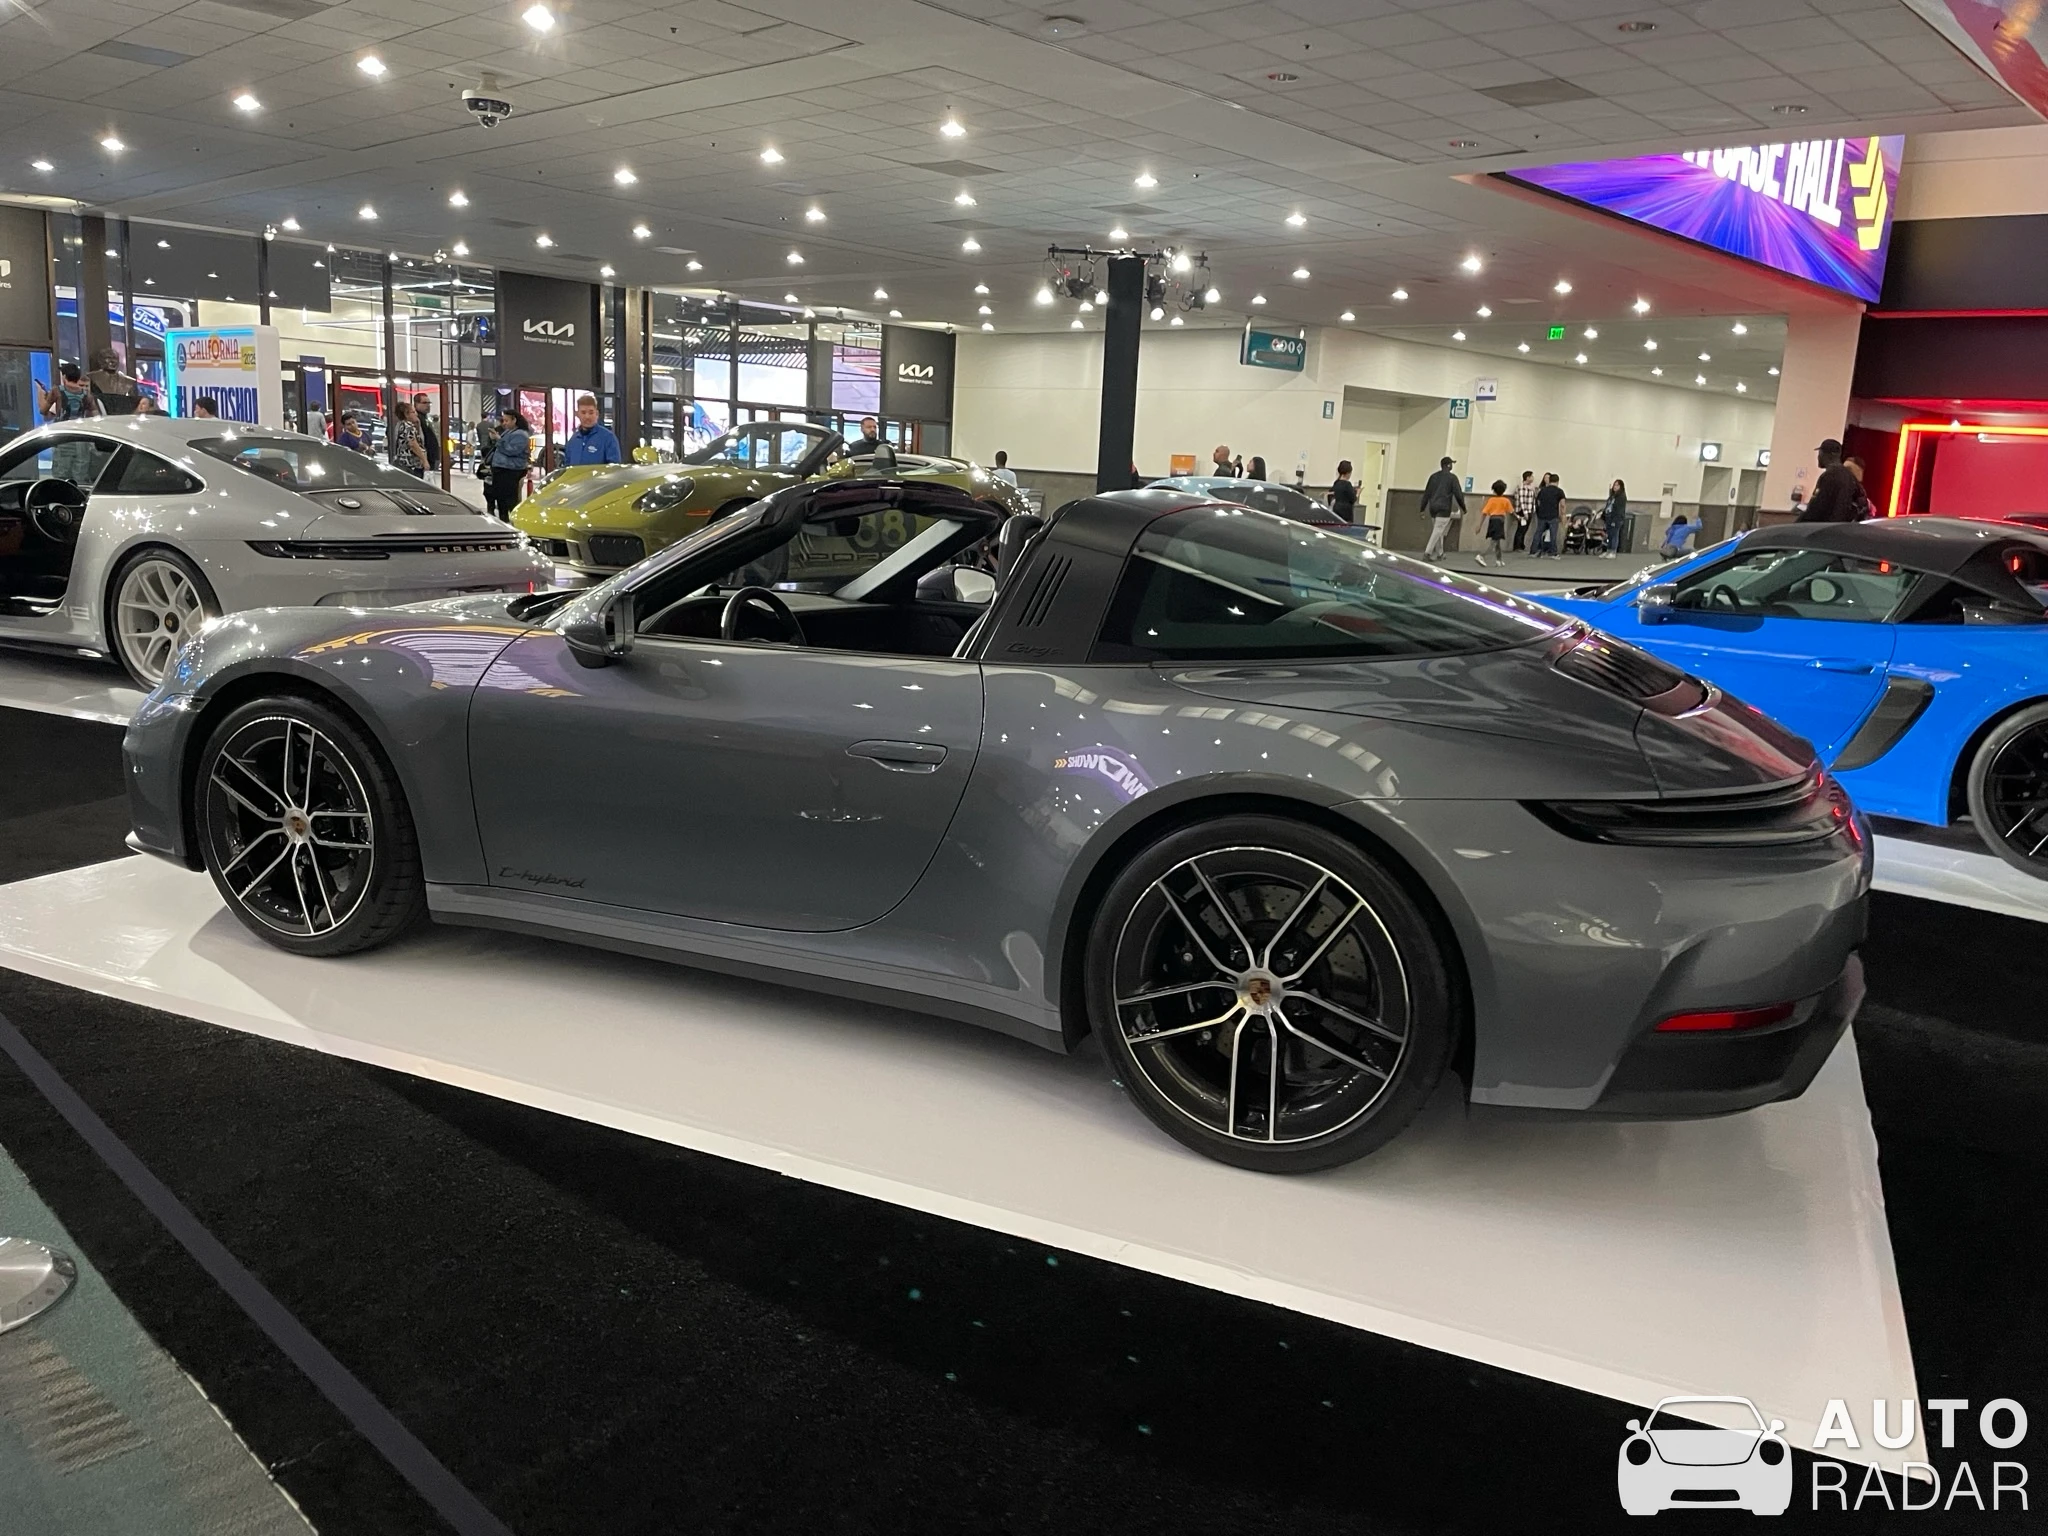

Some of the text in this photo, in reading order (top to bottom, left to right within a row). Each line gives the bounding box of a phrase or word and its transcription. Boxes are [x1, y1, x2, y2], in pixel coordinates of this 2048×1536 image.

[1783, 139, 1843, 228] HALL
[133, 307, 161, 332] Ford
[523, 319, 575, 338] KIA
[188, 339, 239, 360] CALIFORNIA
[898, 363, 934, 378] KIA
[424, 544, 508, 554] PORSCHE
